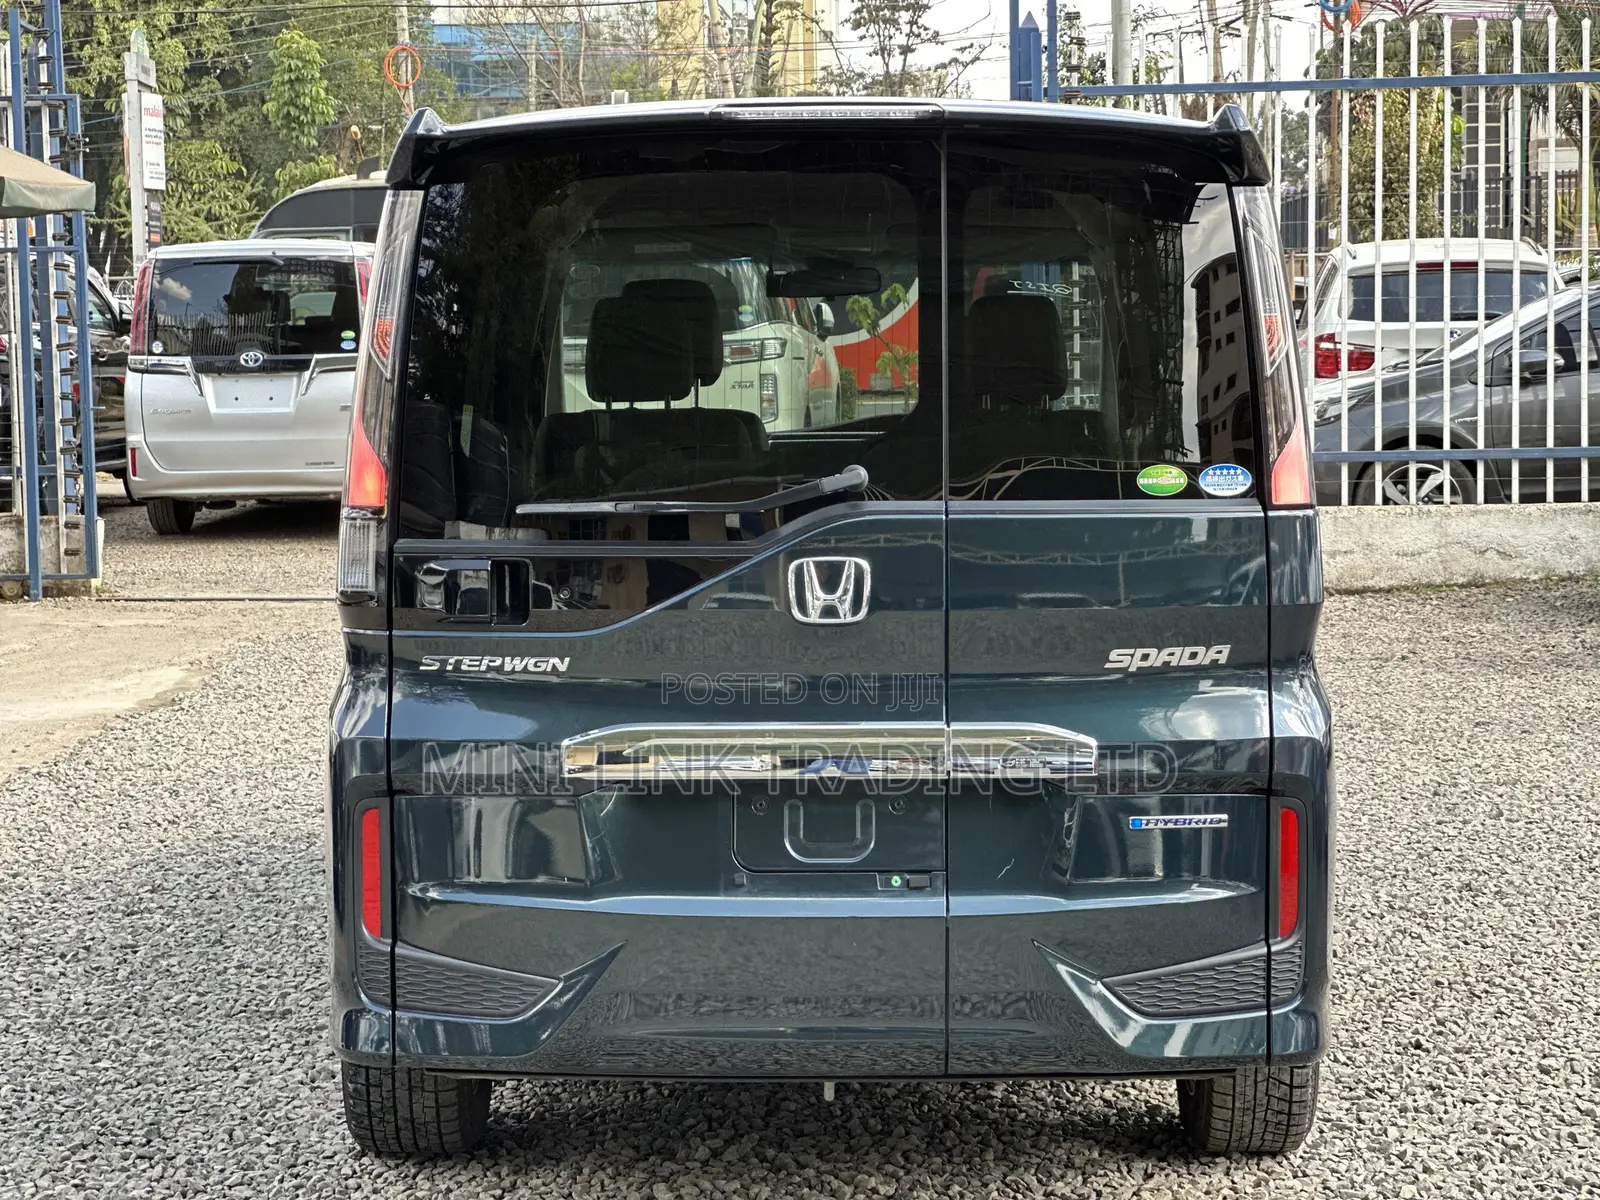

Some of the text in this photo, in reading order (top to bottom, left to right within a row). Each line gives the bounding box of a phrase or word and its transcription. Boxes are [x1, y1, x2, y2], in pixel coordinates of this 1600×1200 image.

[419, 655, 570, 673] STEPWGN
[1104, 644, 1231, 672] SPADA
[1143, 817, 1223, 827] HYBRID
